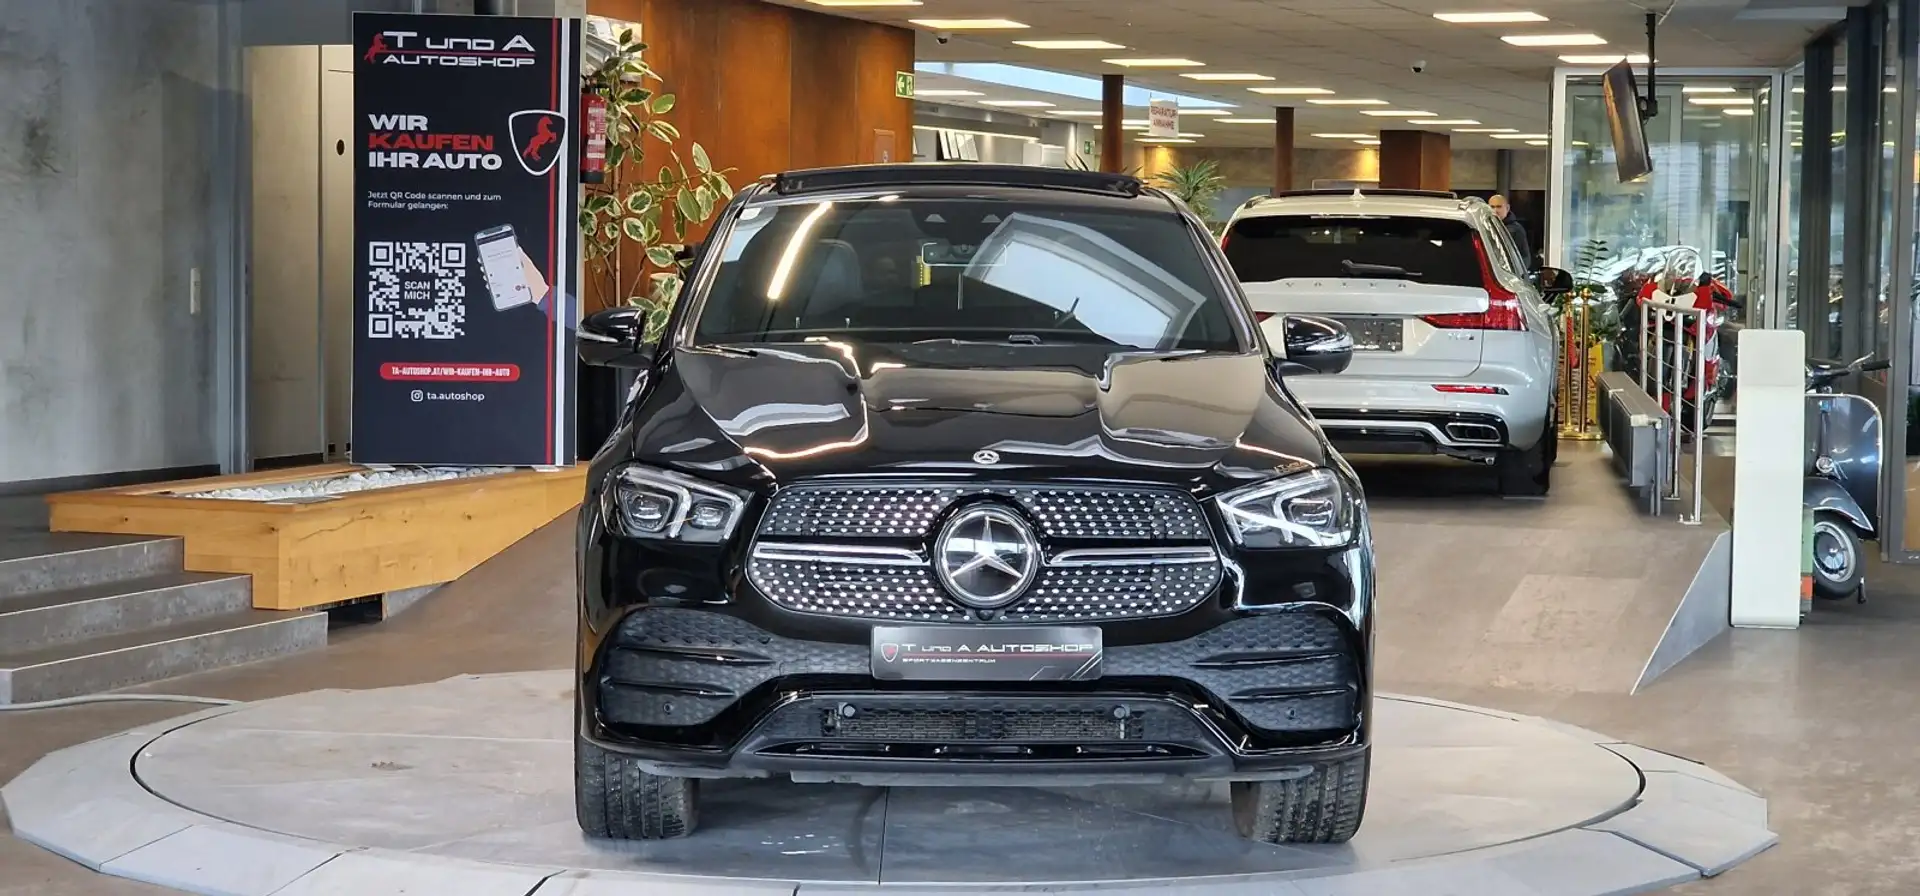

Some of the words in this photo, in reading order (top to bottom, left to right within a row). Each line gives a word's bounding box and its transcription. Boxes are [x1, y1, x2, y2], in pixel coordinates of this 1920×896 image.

[383, 31, 418, 48] T
[502, 34, 536, 52] A
[383, 54, 536, 67] AUTOSHOP
[368, 114, 428, 131] WIR
[368, 132, 494, 151] KAUFEN
[368, 152, 419, 169] IHR
[421, 153, 503, 171] AUTO
[367, 190, 388, 200] Jetzt
[389, 191, 403, 201] QR
[404, 191, 426, 201] Code
[427, 192, 463, 201] scannen
[464, 191, 482, 201] und
[367, 200, 406, 210] Formular
[407, 200, 449, 211] gelangen:
[404, 281, 431, 290] SCAN
[404, 290, 431, 300] MICH
[391, 366, 511, 377] TA-AUTOSHOP.AT/WIR-KAUFEN-IHR-AUTO
[426, 391, 485, 402] ta.autoshop
[901, 643, 916, 652] T
[957, 643, 972, 652] A
[976, 643, 1094, 653] AUTOSHOP
